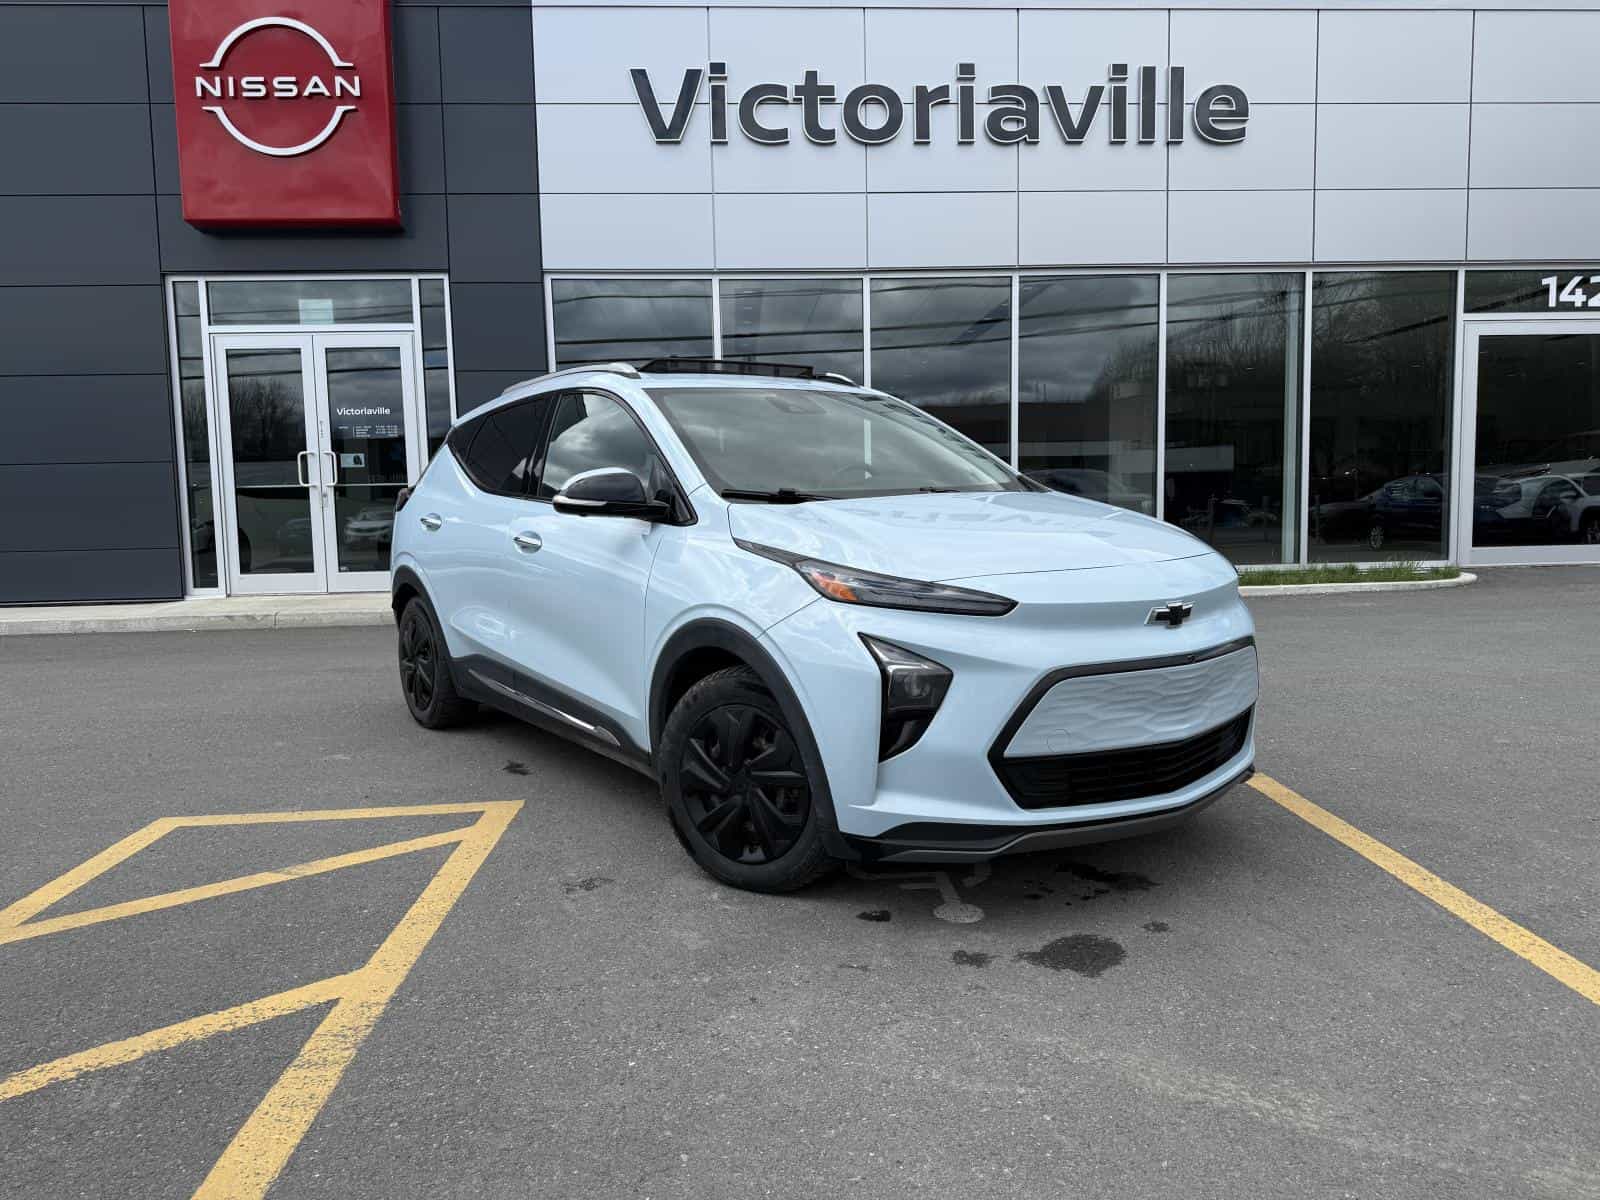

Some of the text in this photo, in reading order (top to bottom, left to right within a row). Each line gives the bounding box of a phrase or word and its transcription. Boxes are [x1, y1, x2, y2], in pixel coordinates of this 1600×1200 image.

[195, 75, 361, 97] NISSAN
[629, 61, 1249, 145] Victoriaville
[336, 407, 391, 416] Victoriaville
